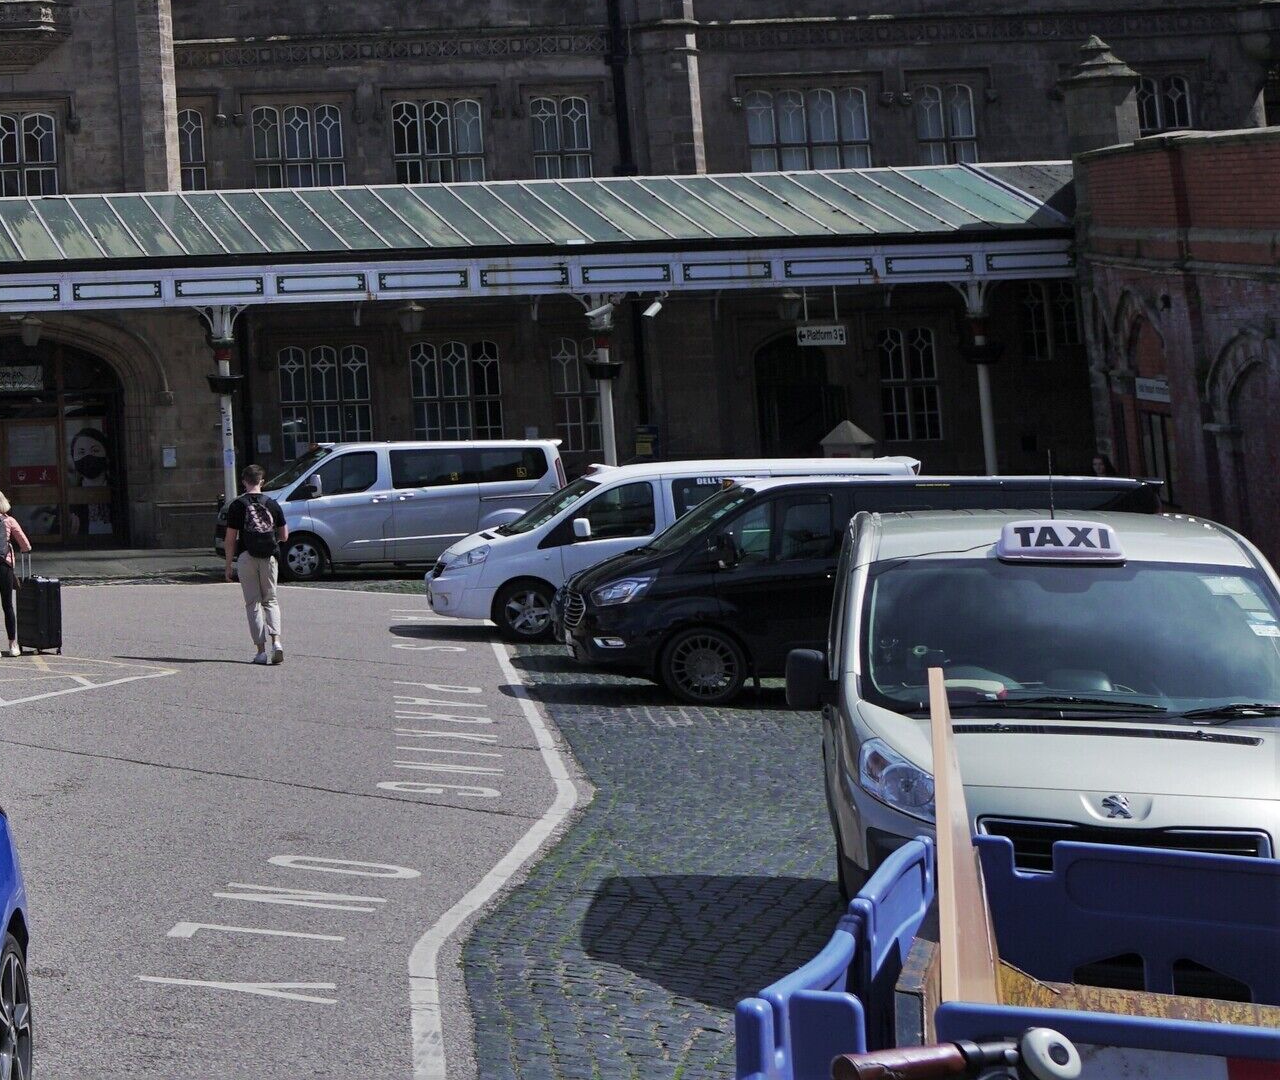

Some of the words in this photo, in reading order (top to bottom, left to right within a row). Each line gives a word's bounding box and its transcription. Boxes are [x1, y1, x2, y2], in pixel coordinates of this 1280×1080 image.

[1014, 526, 1111, 550] TAXI
[376, 680, 505, 798] PARKING
[135, 854, 421, 1004] ONLY
